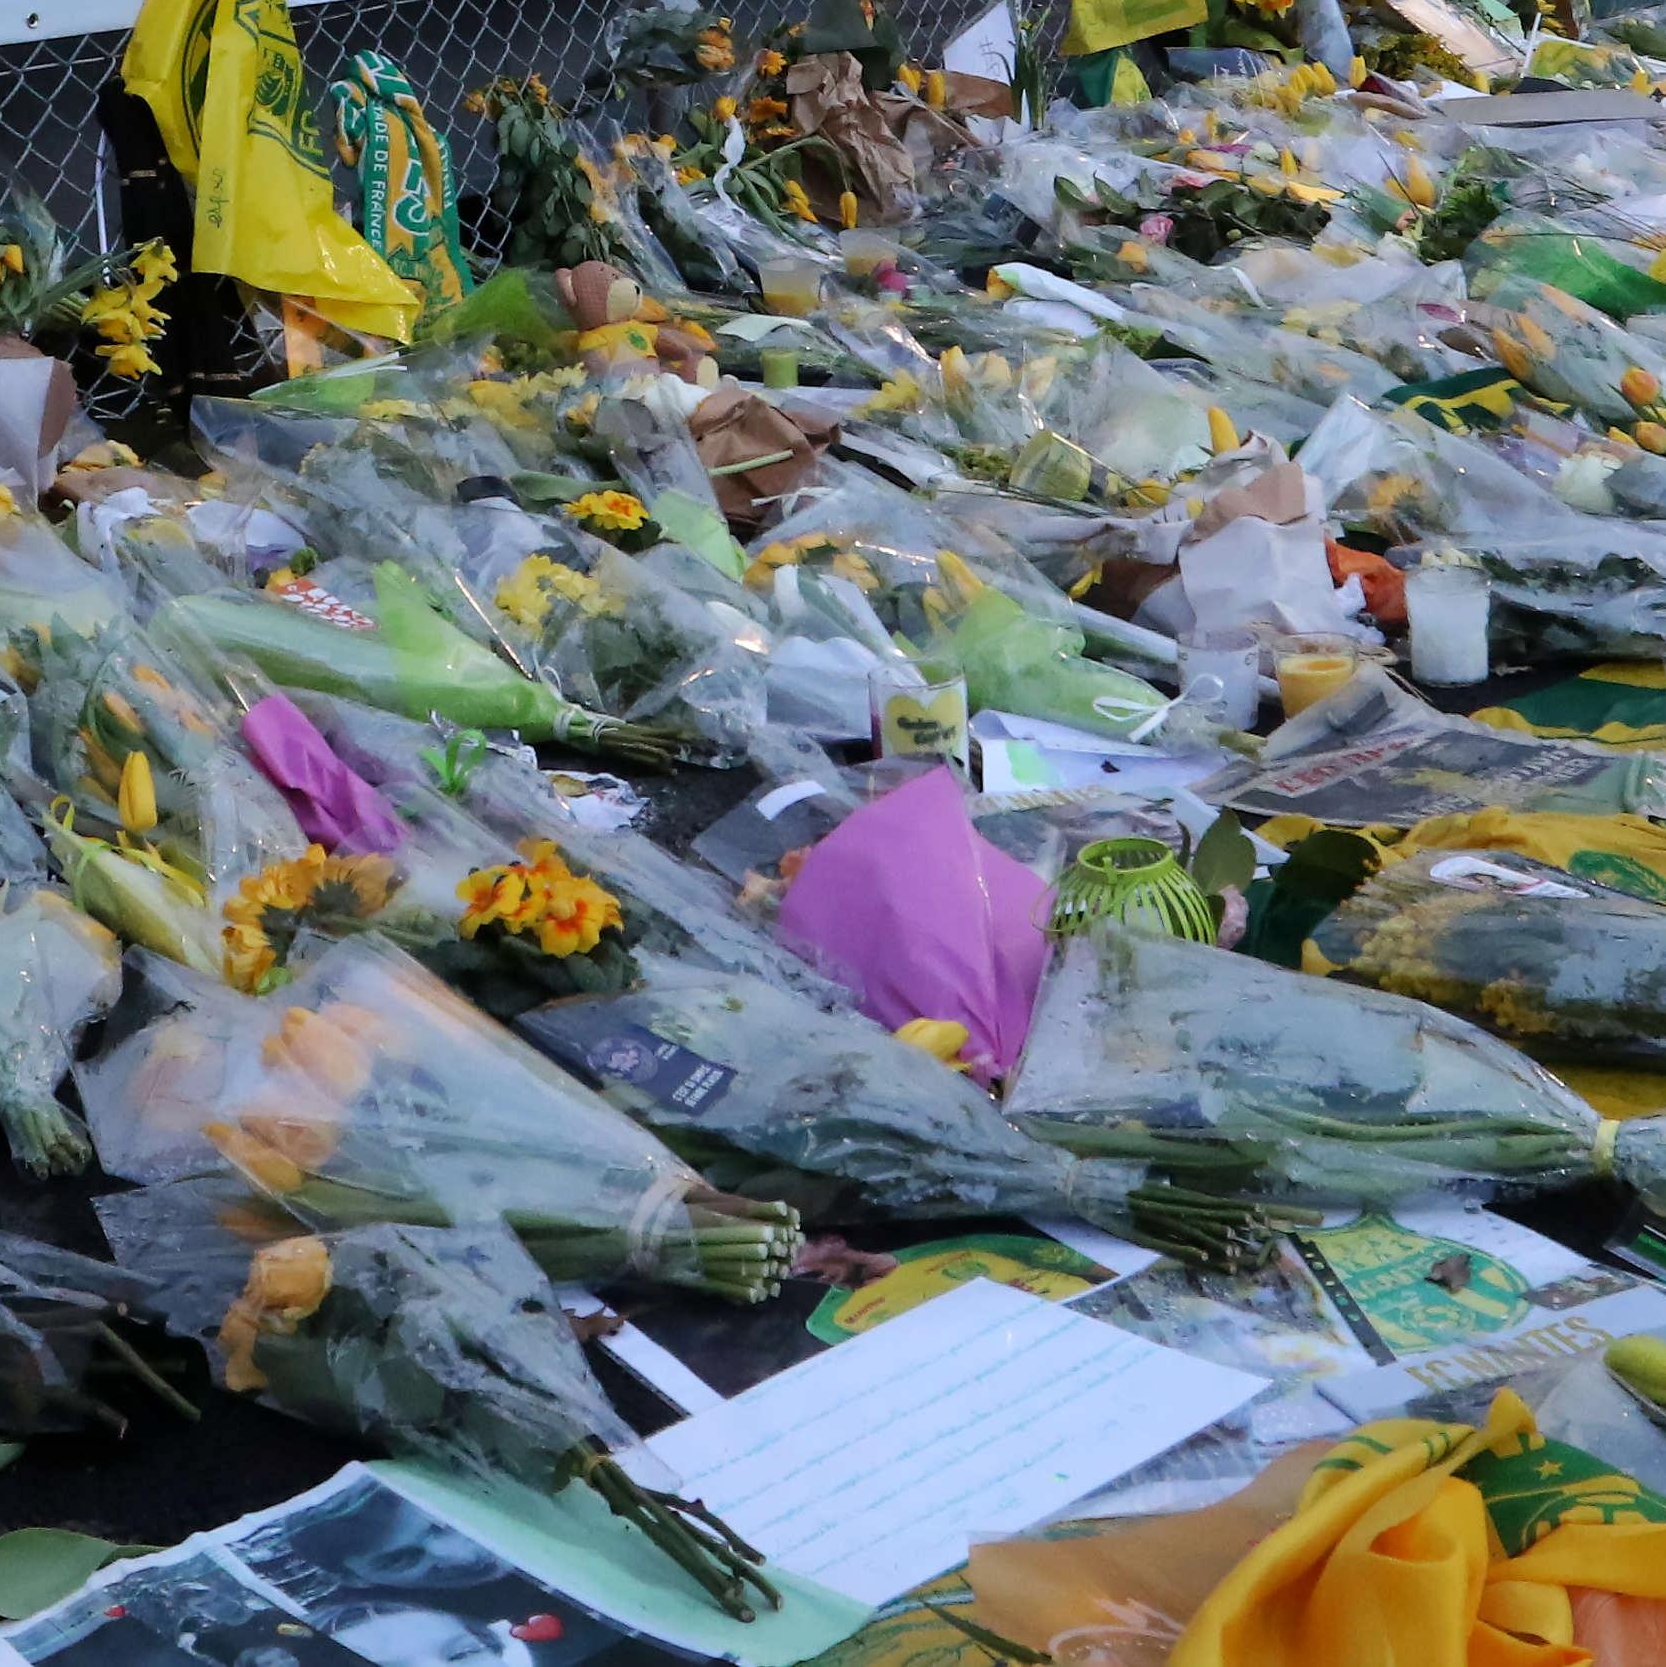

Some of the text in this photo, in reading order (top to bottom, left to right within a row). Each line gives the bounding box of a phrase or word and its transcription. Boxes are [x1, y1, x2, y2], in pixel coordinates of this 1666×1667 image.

[298, 109, 323, 156] FC
[373, 154, 388, 173] DE
[370, 181, 386, 249] FRANCE
[1452, 1316, 1616, 1386] NANTES
